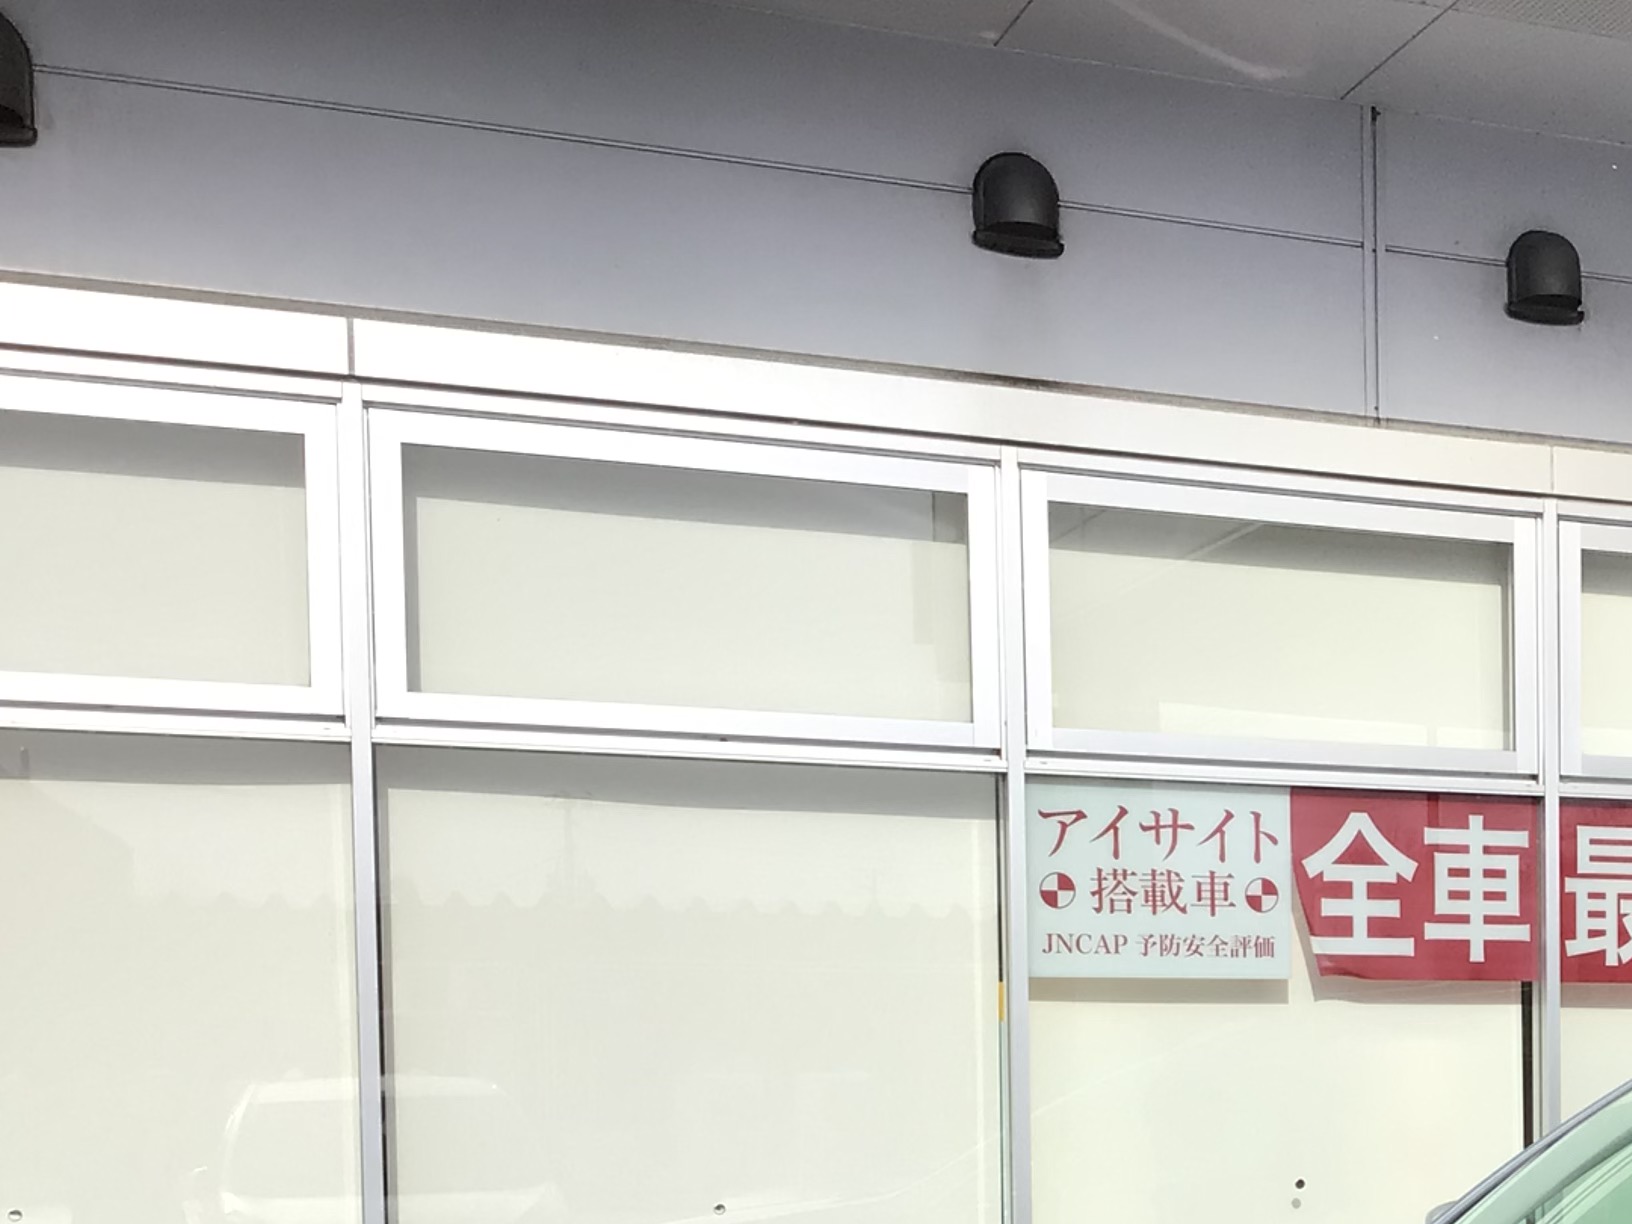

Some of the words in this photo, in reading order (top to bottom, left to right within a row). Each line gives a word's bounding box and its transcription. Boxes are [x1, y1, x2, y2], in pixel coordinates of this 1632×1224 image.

[1036, 804, 1280, 864] アイサイト
[1089, 867, 1237, 917] 搭載車
[1300, 811, 1531, 963] 全車
[1042, 932, 1128, 955] JNCAP
[1137, 933, 1276, 959] 予防安全評価
